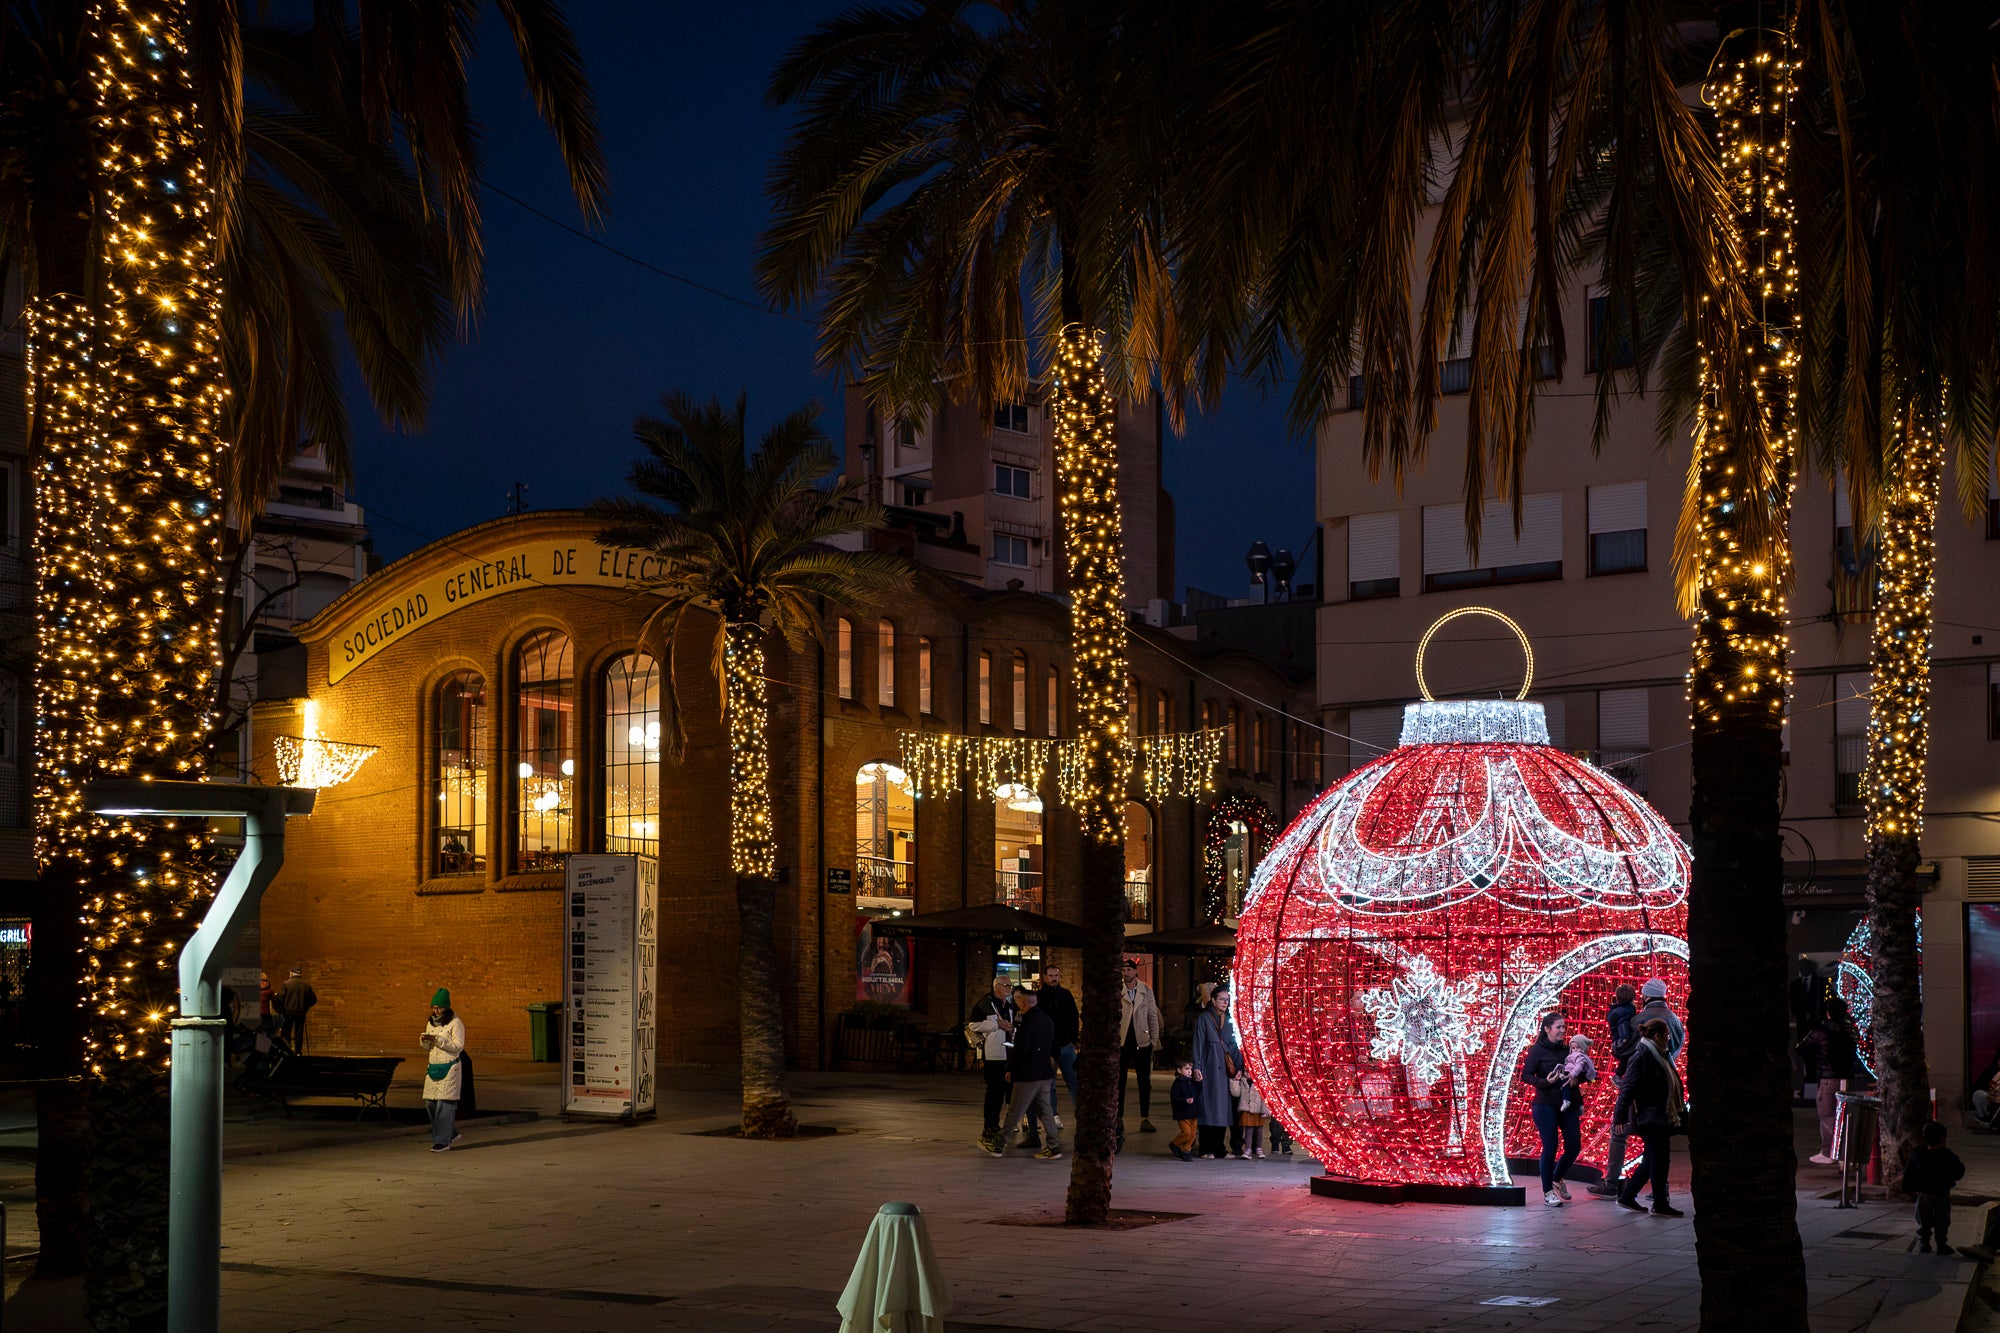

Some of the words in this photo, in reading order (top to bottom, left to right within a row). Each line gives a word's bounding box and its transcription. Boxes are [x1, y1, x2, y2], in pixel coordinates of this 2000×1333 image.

[343, 594, 428, 662] SOCIEDAD
[445, 553, 532, 603] GENERAL
[553, 548, 576, 575] DE
[533, 781, 564, 792] VENA
[640, 860, 657, 885] WHAT
[0, 929, 27, 943] GRILL
